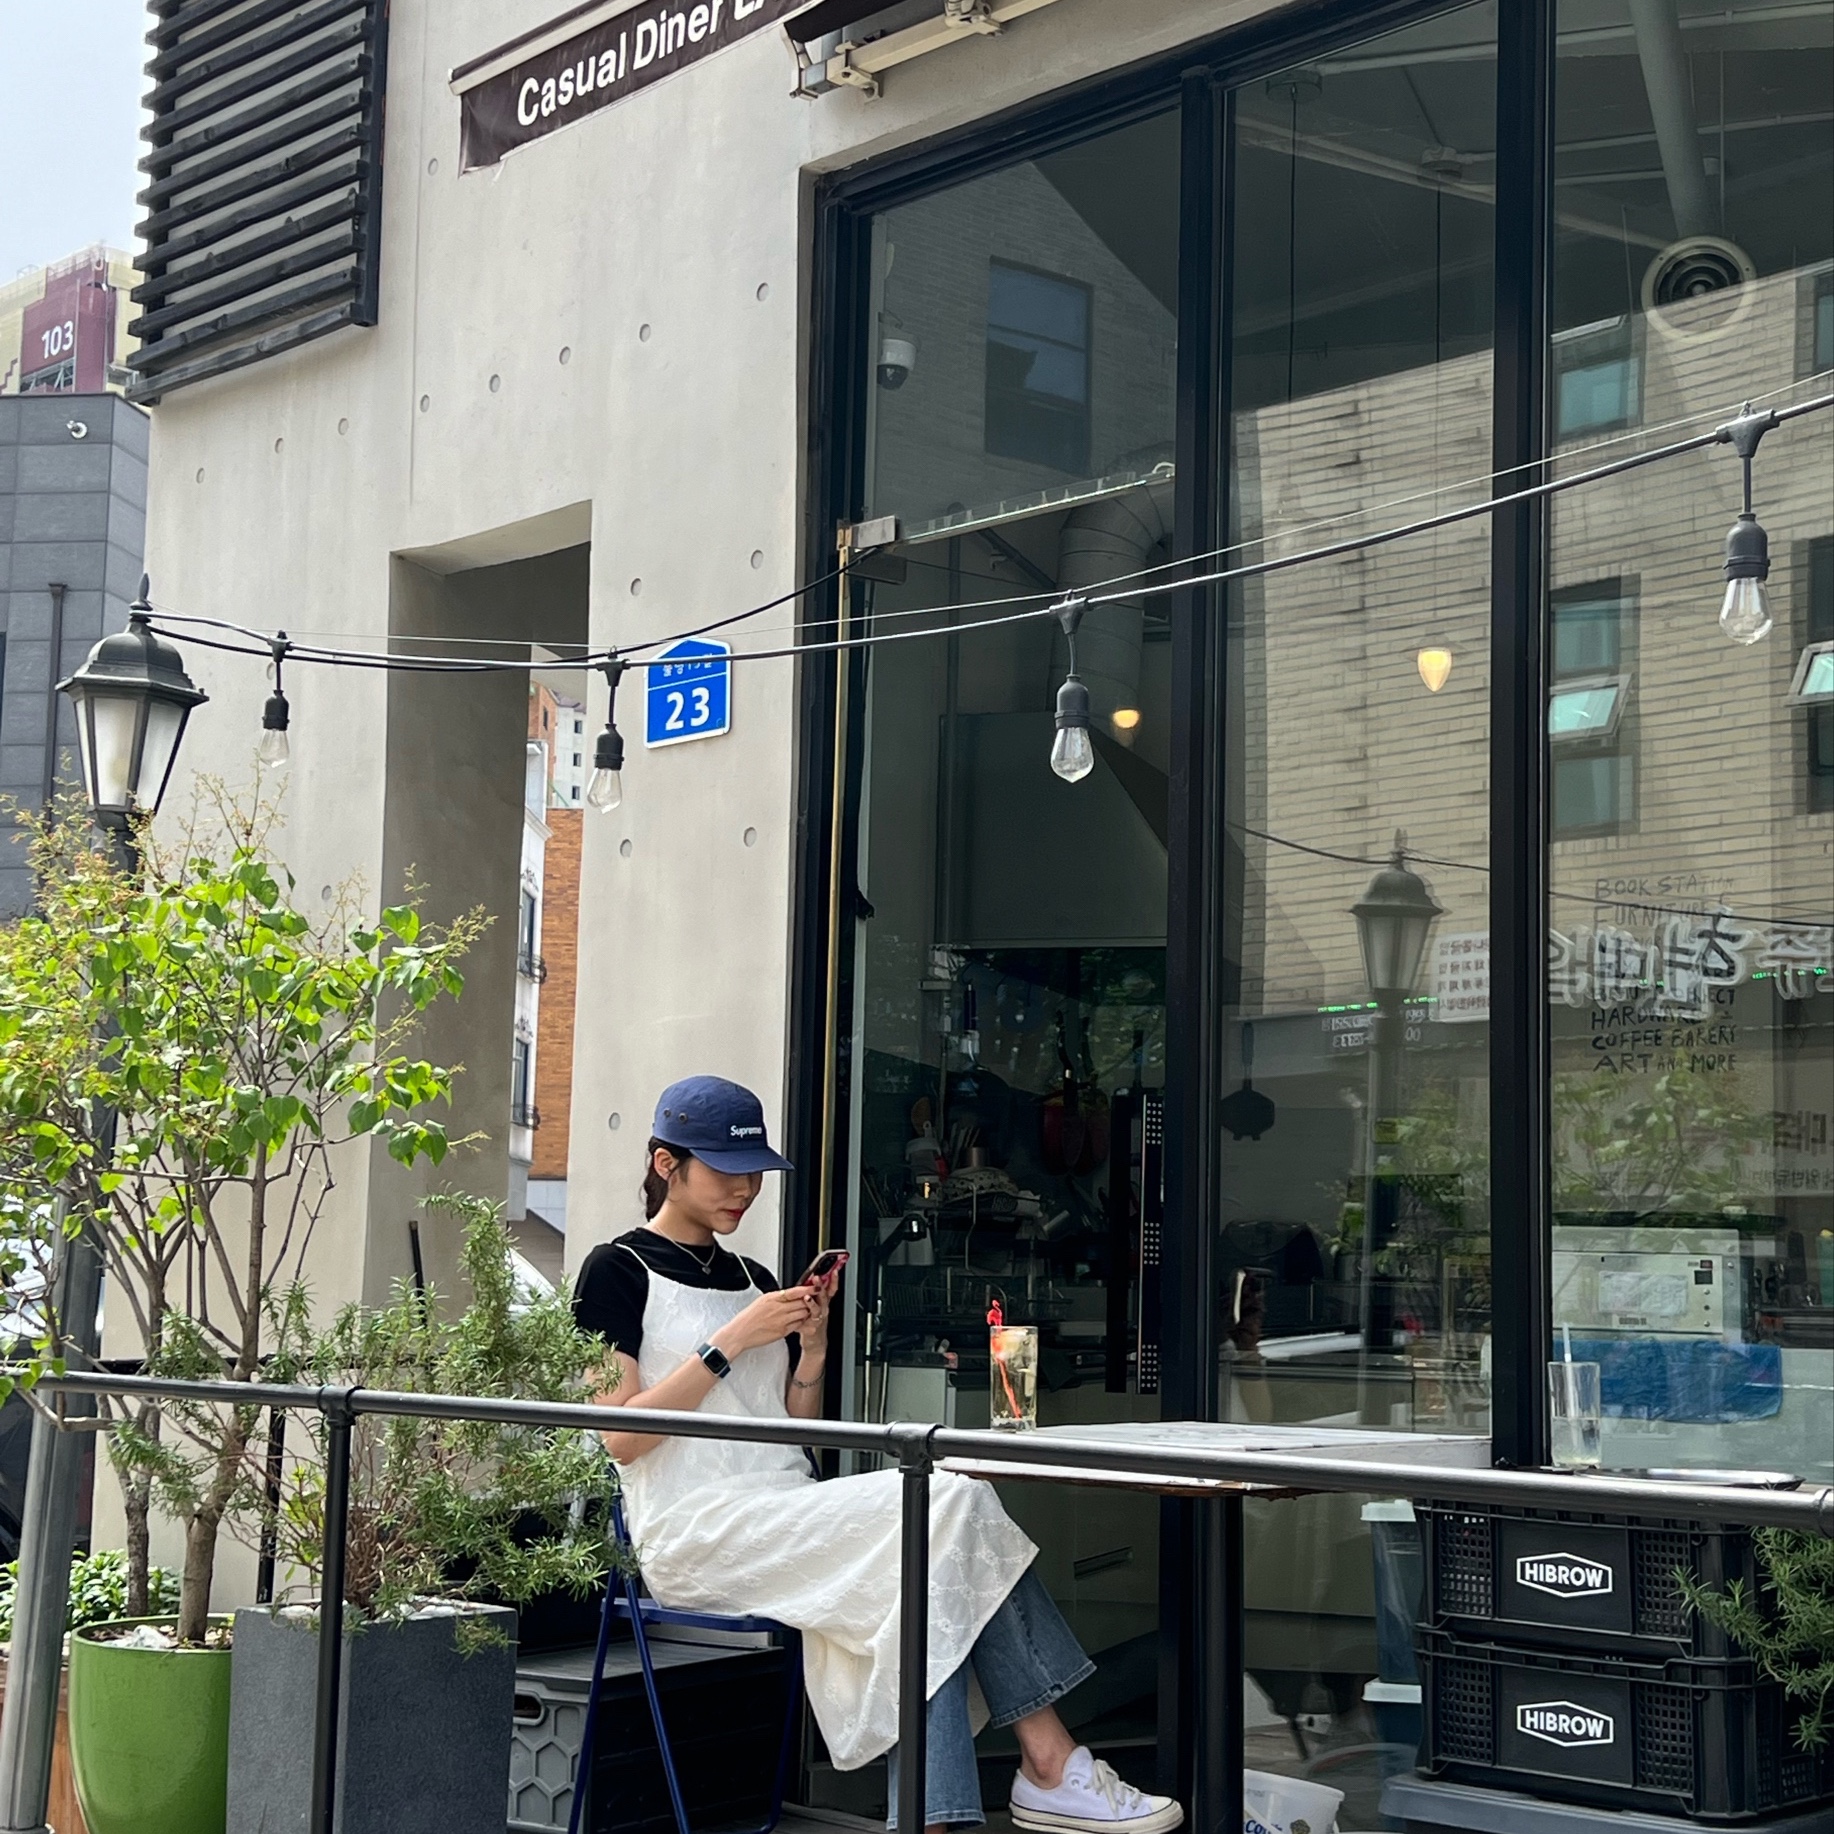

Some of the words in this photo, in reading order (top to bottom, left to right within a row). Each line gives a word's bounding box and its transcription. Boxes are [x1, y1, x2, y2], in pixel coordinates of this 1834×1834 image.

[516, 32, 628, 127] Casual
[633, 0, 725, 71] Diner
[41, 320, 74, 359] 103
[665, 686, 710, 731] 23
[1595, 878, 1651, 900] BOOK
[1592, 1028, 1662, 1050] COFFEE
[1671, 1024, 1737, 1047] BAKERY
[1593, 1053, 1653, 1074] ART
[1689, 1053, 1737, 1073] MORE
[730, 1125, 762, 1138] Supreme
[1525, 1562, 1604, 1588] HIBROW
[1525, 1710, 1604, 1738] HIBROW
